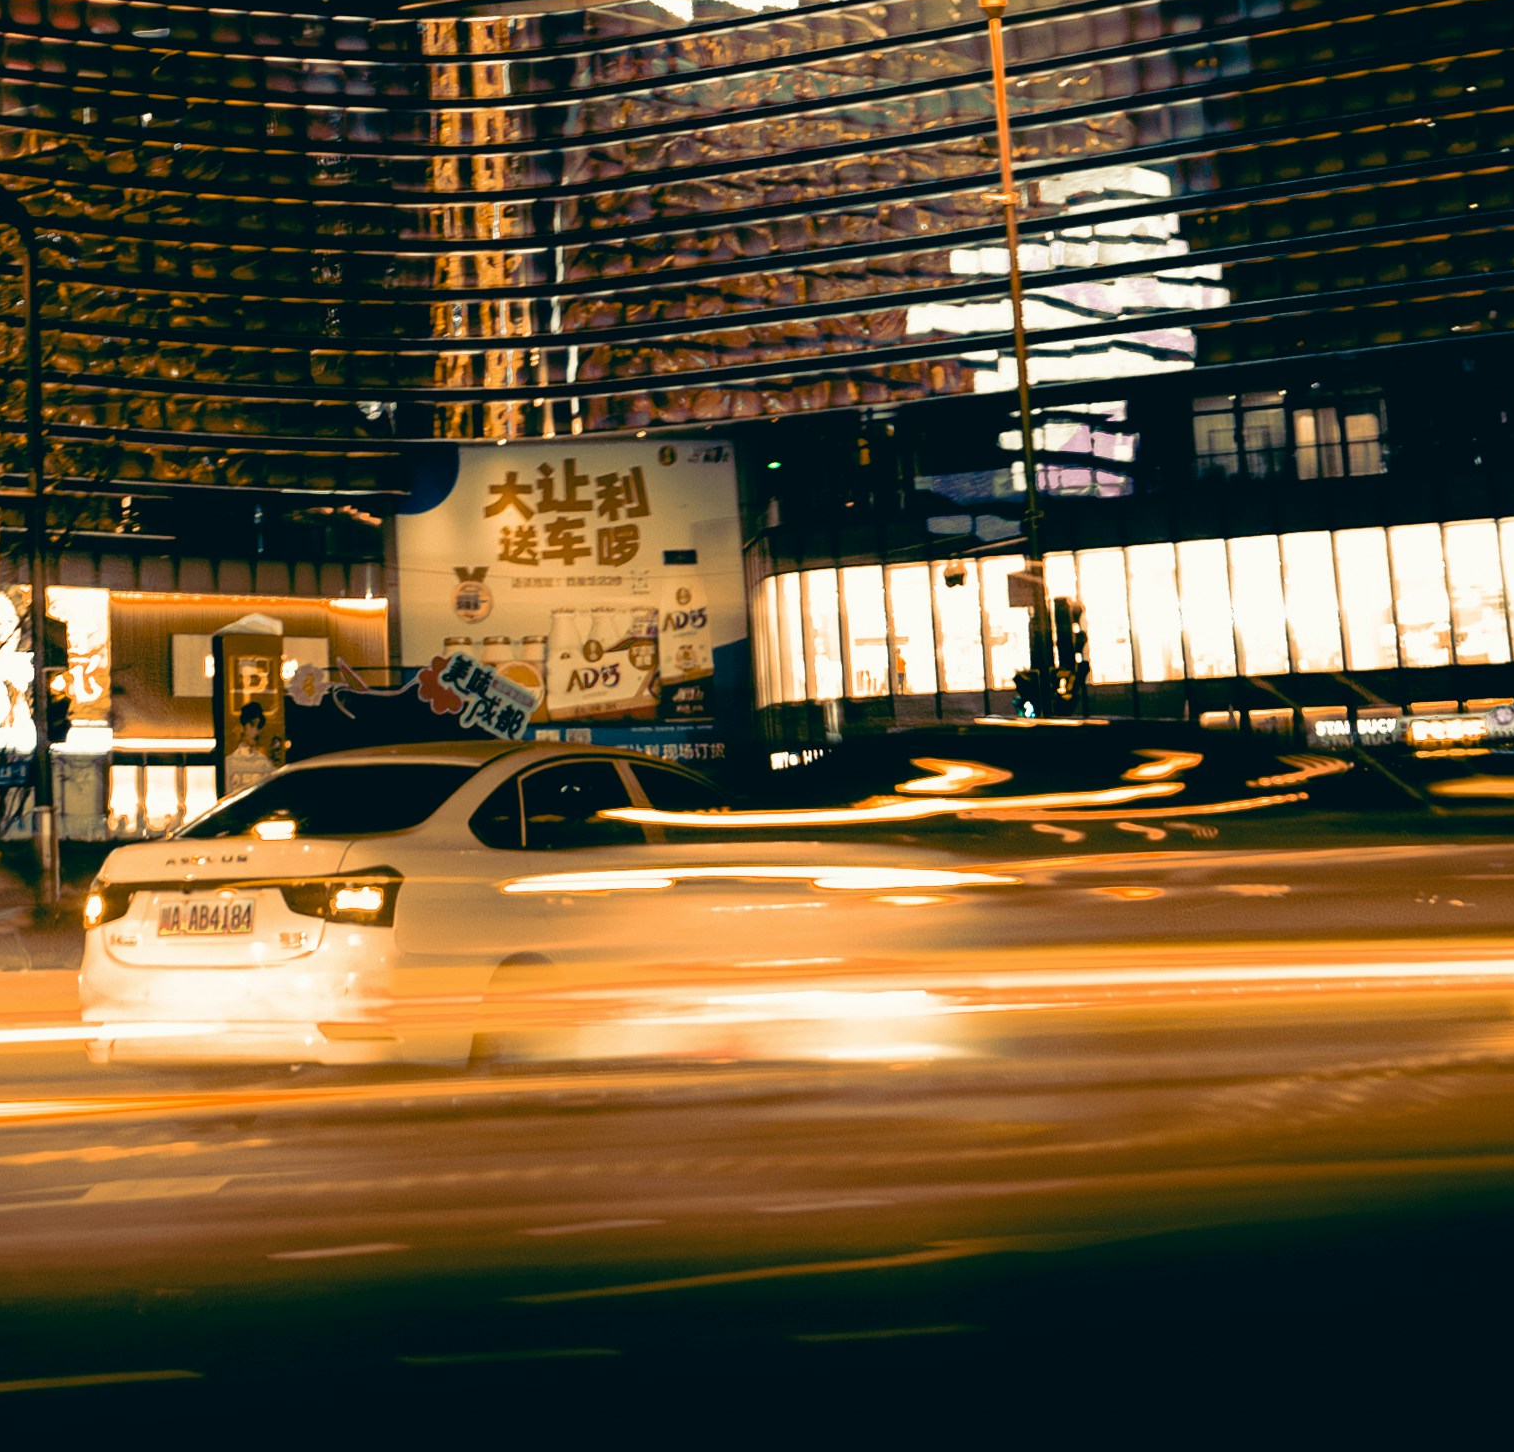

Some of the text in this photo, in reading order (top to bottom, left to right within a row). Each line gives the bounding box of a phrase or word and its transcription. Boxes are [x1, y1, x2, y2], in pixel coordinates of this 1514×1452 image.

[484, 457, 651, 522] 大让利
[464, 695, 526, 740] 成都
